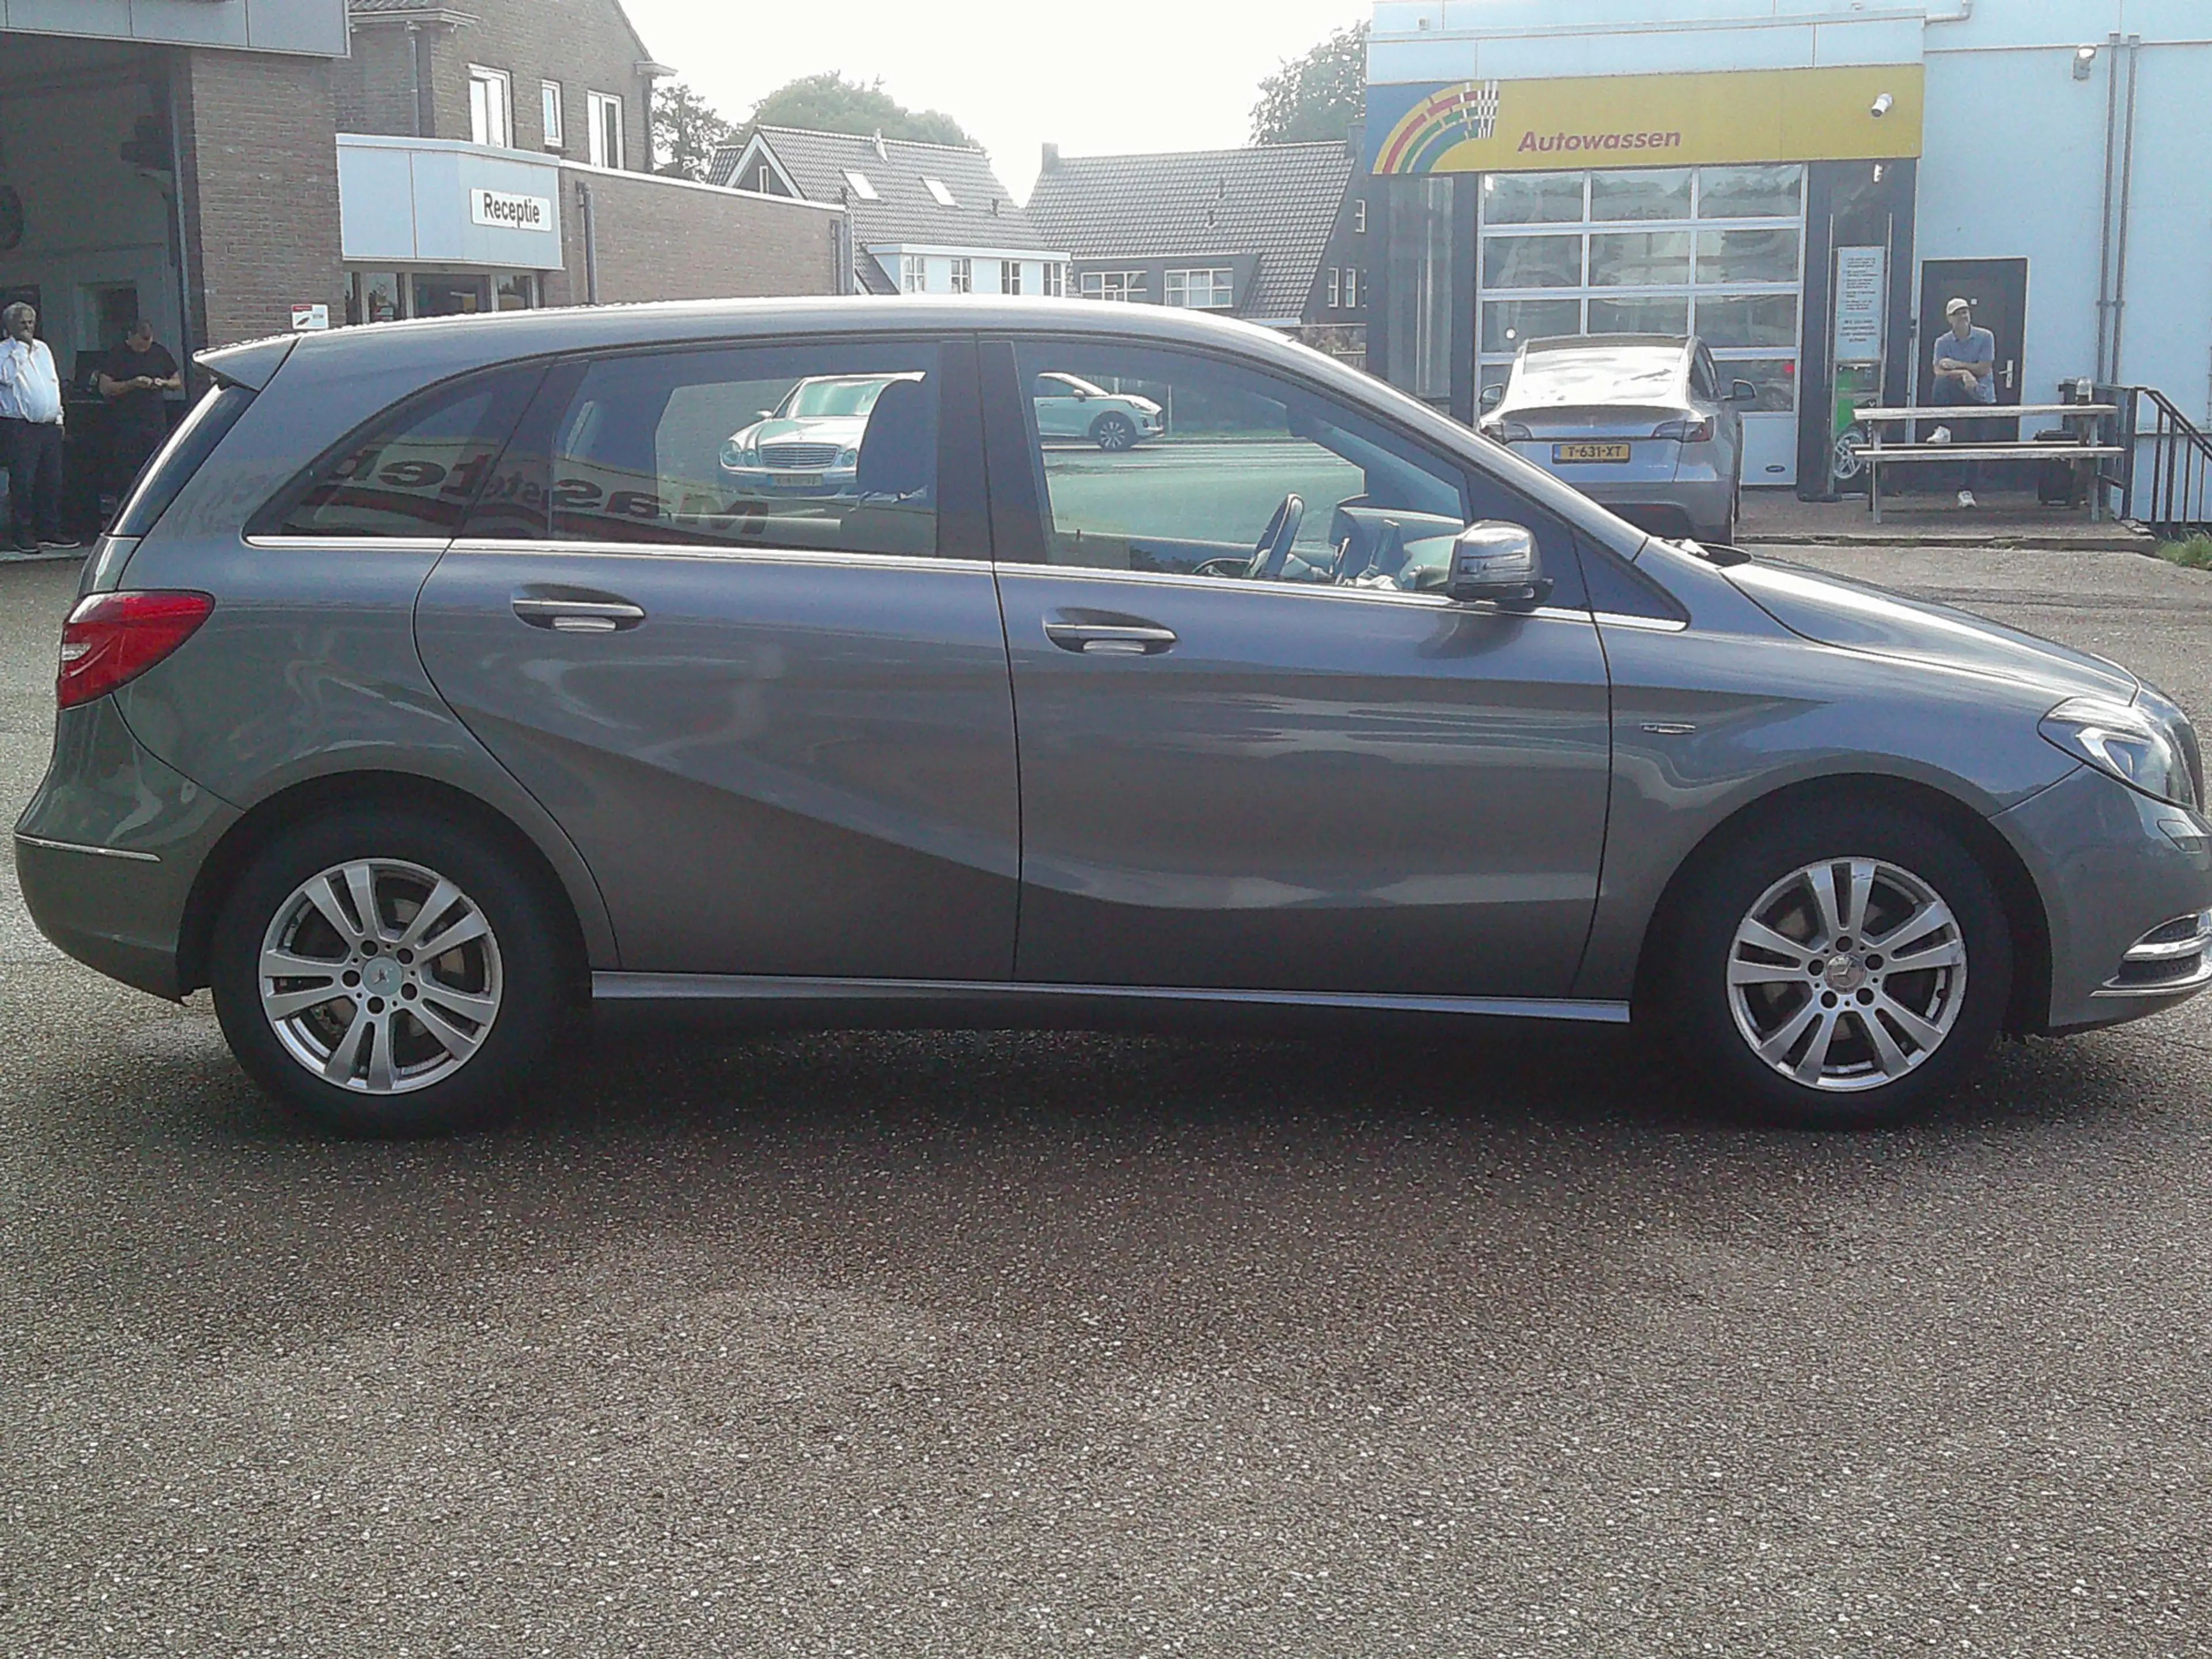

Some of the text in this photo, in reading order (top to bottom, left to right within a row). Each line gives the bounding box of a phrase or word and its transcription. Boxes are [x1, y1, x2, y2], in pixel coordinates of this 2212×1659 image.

[1517, 131, 1681, 152] Autowassen
[483, 192, 540, 228] Receptie
[1568, 446, 1622, 457] T-631-XT
